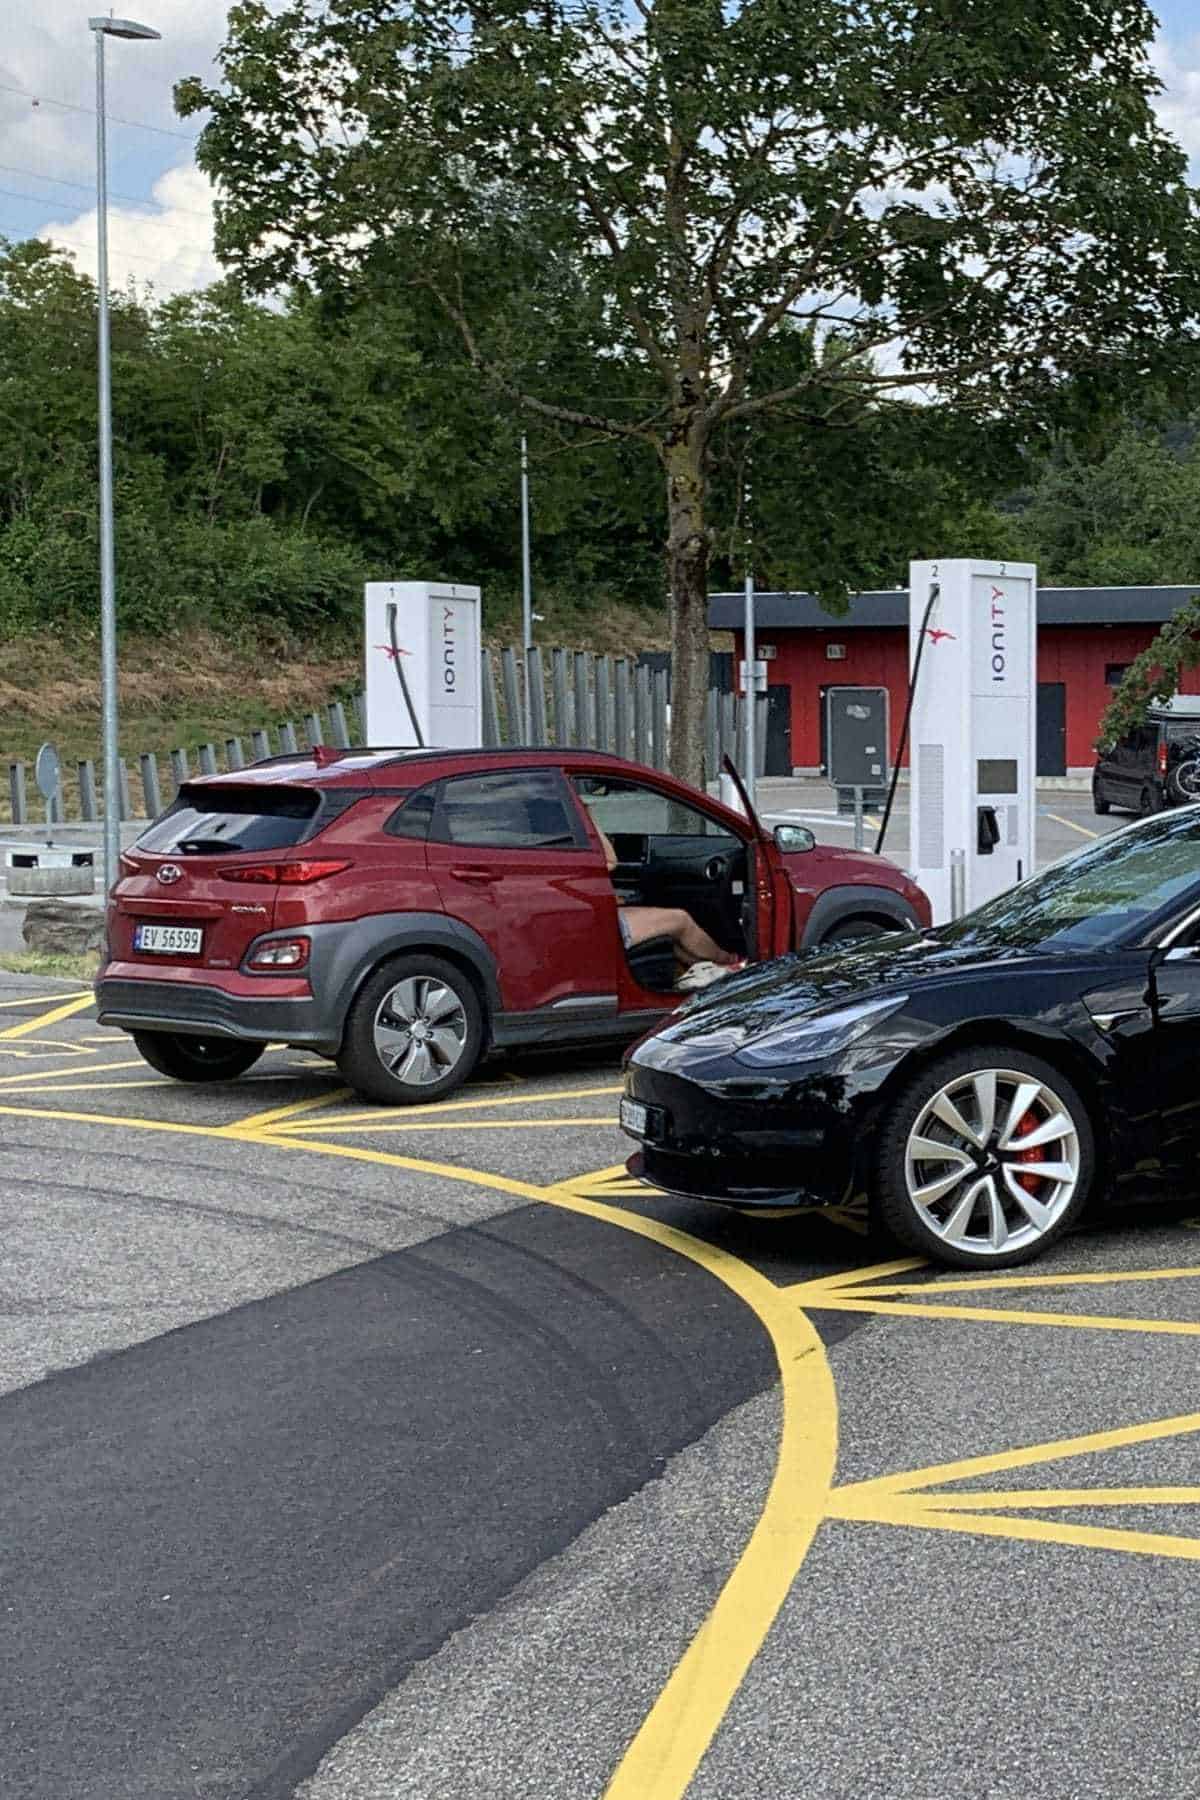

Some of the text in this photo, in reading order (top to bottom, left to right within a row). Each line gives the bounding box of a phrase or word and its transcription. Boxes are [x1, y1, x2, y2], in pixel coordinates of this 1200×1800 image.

[931, 565, 939, 577] 2
[999, 563, 1006, 575] 2
[992, 586, 1005, 681] IONITY
[444, 607, 455, 693] IONITY
[143, 928, 199, 949] EV 56599
